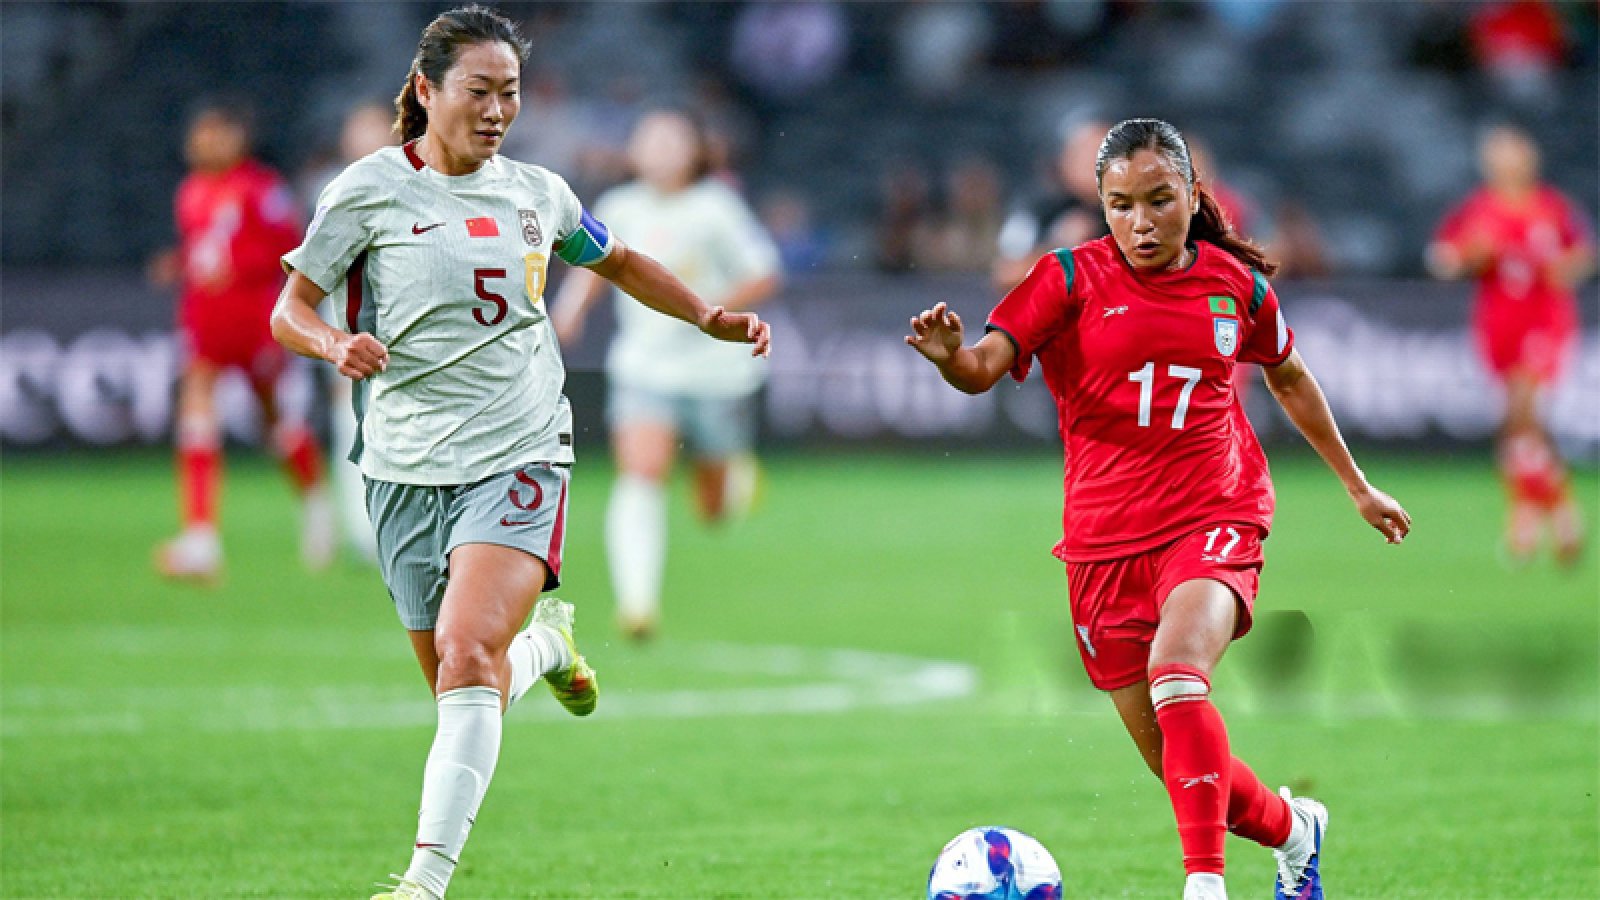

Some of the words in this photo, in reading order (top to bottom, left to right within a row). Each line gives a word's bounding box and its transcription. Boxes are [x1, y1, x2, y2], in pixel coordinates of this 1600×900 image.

[472, 268, 508, 327] 5
[1128, 362, 1202, 429] 17
[508, 466, 545, 510] 5
[1203, 527, 1241, 557] 17
